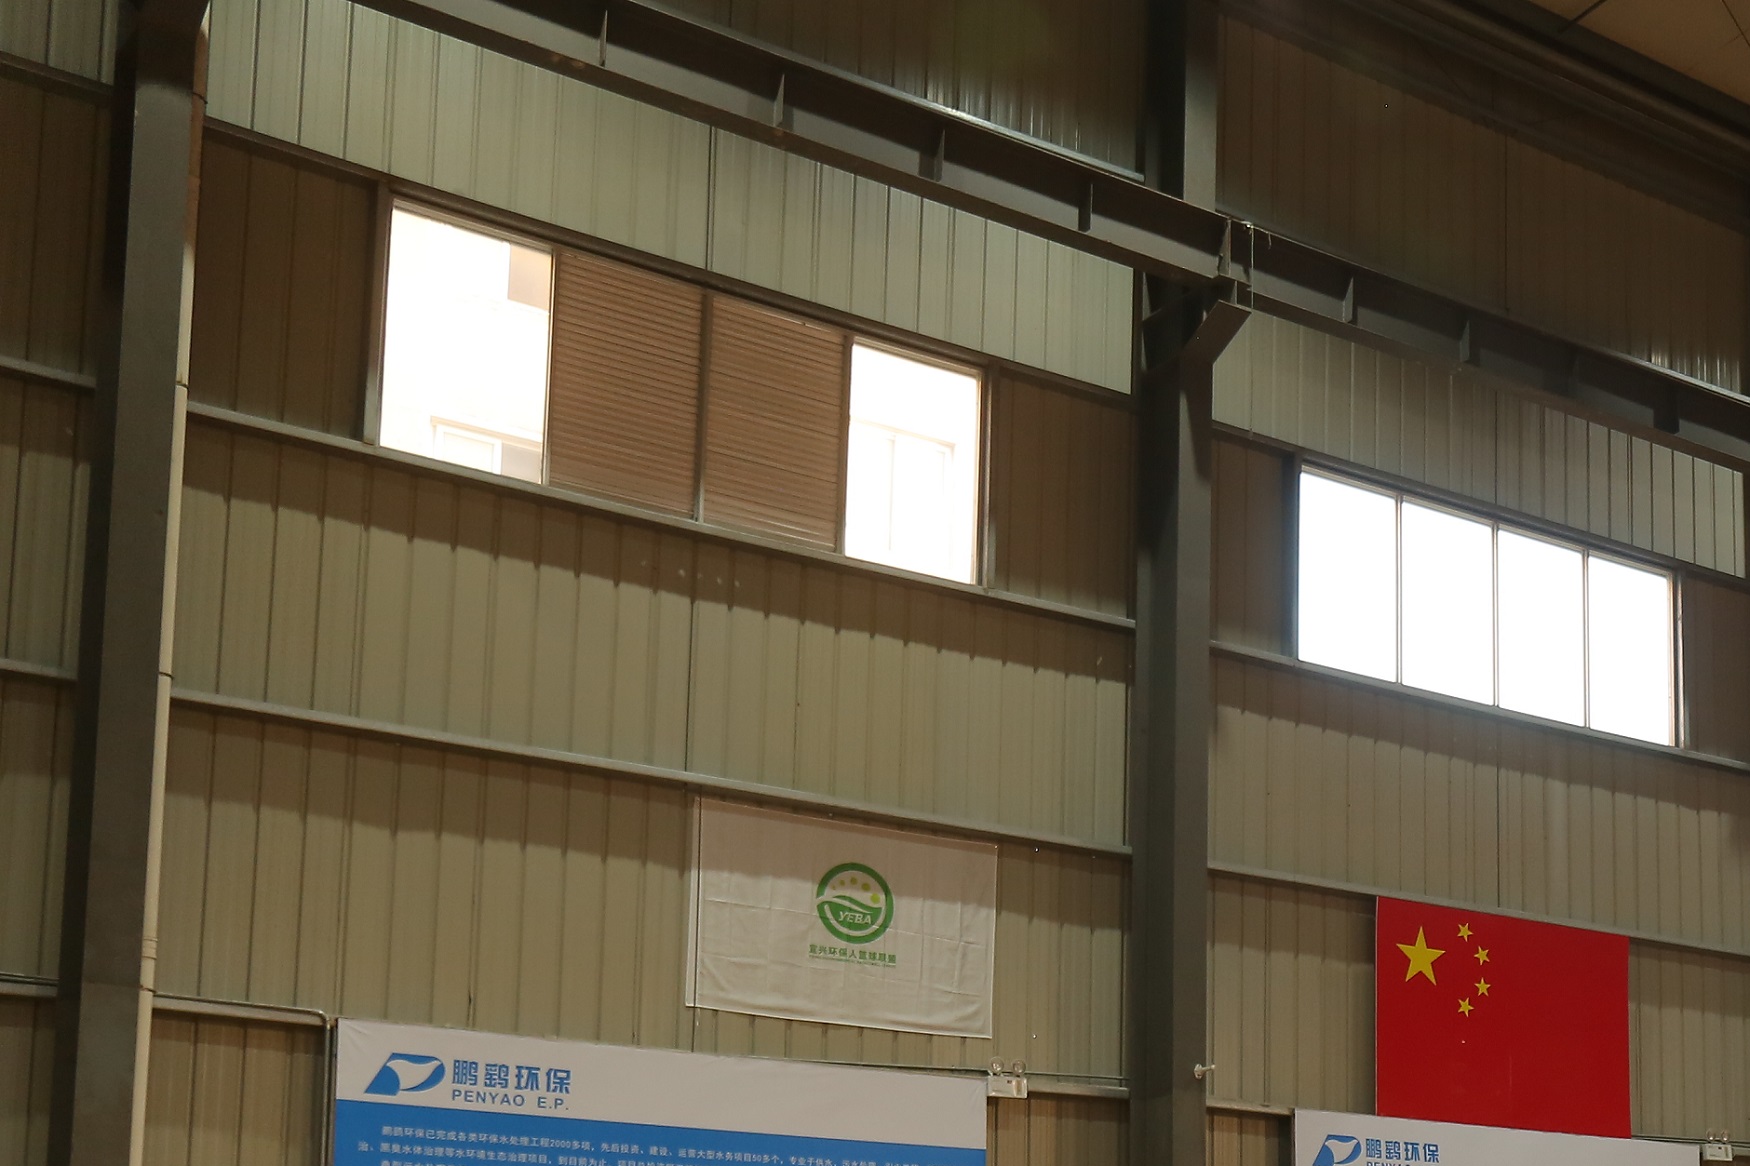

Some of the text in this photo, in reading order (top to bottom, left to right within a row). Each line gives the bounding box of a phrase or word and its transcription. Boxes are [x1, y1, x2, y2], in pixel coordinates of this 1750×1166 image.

[838, 911, 872, 924] YEBA
[452, 1059, 571, 1094] 鹏鹞环保
[452, 1089, 569, 1110] PENYAO E.P.
[1366, 1138, 1440, 1163] 鹏鹞环保
